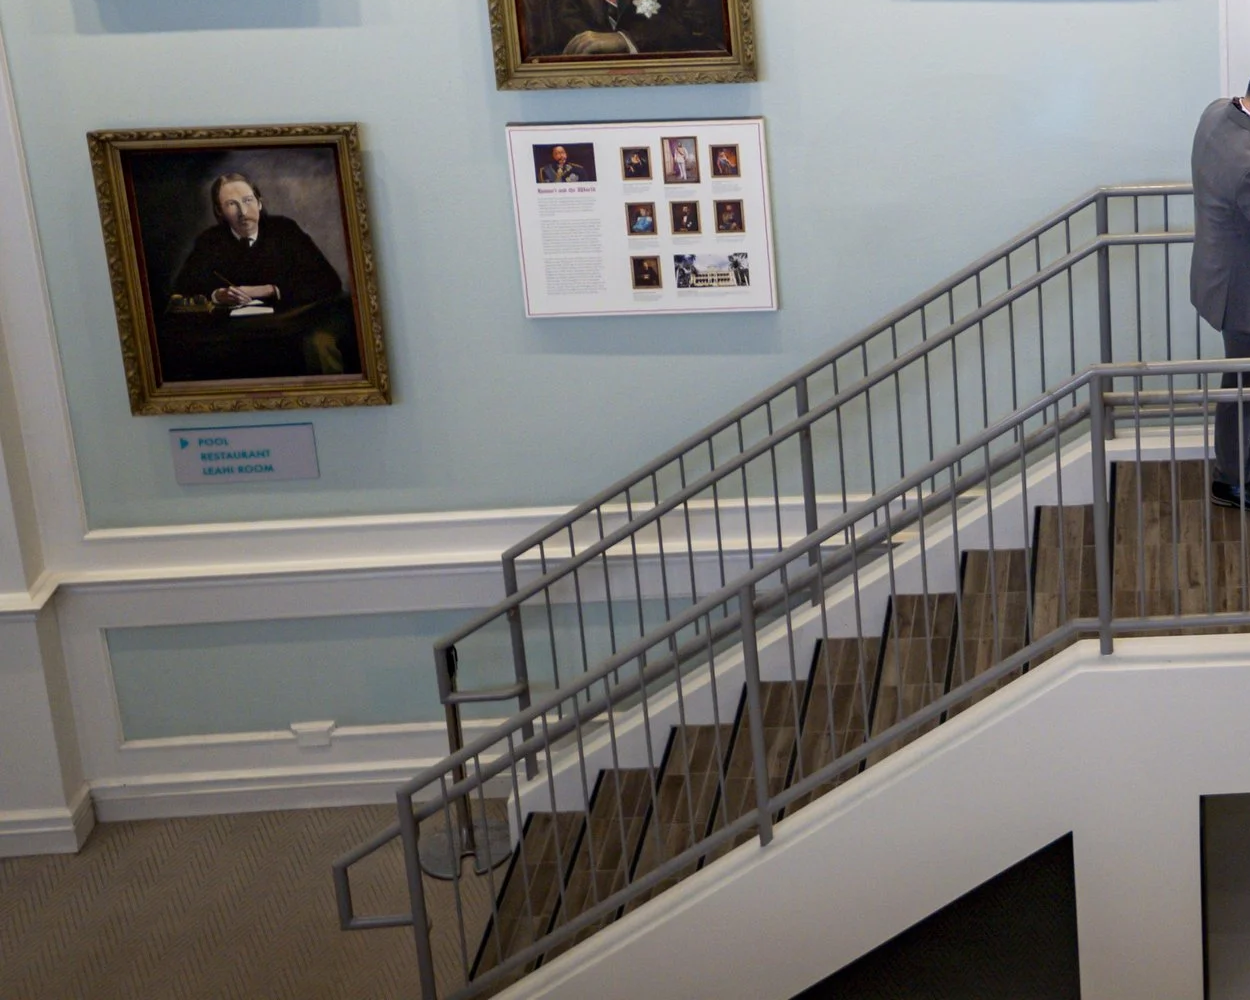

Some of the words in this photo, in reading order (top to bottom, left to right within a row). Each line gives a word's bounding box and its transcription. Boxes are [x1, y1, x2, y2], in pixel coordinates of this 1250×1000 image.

[198, 437, 229, 447] POOL
[200, 449, 270, 461] RESTAURANT
[237, 464, 274, 474] ROOM
